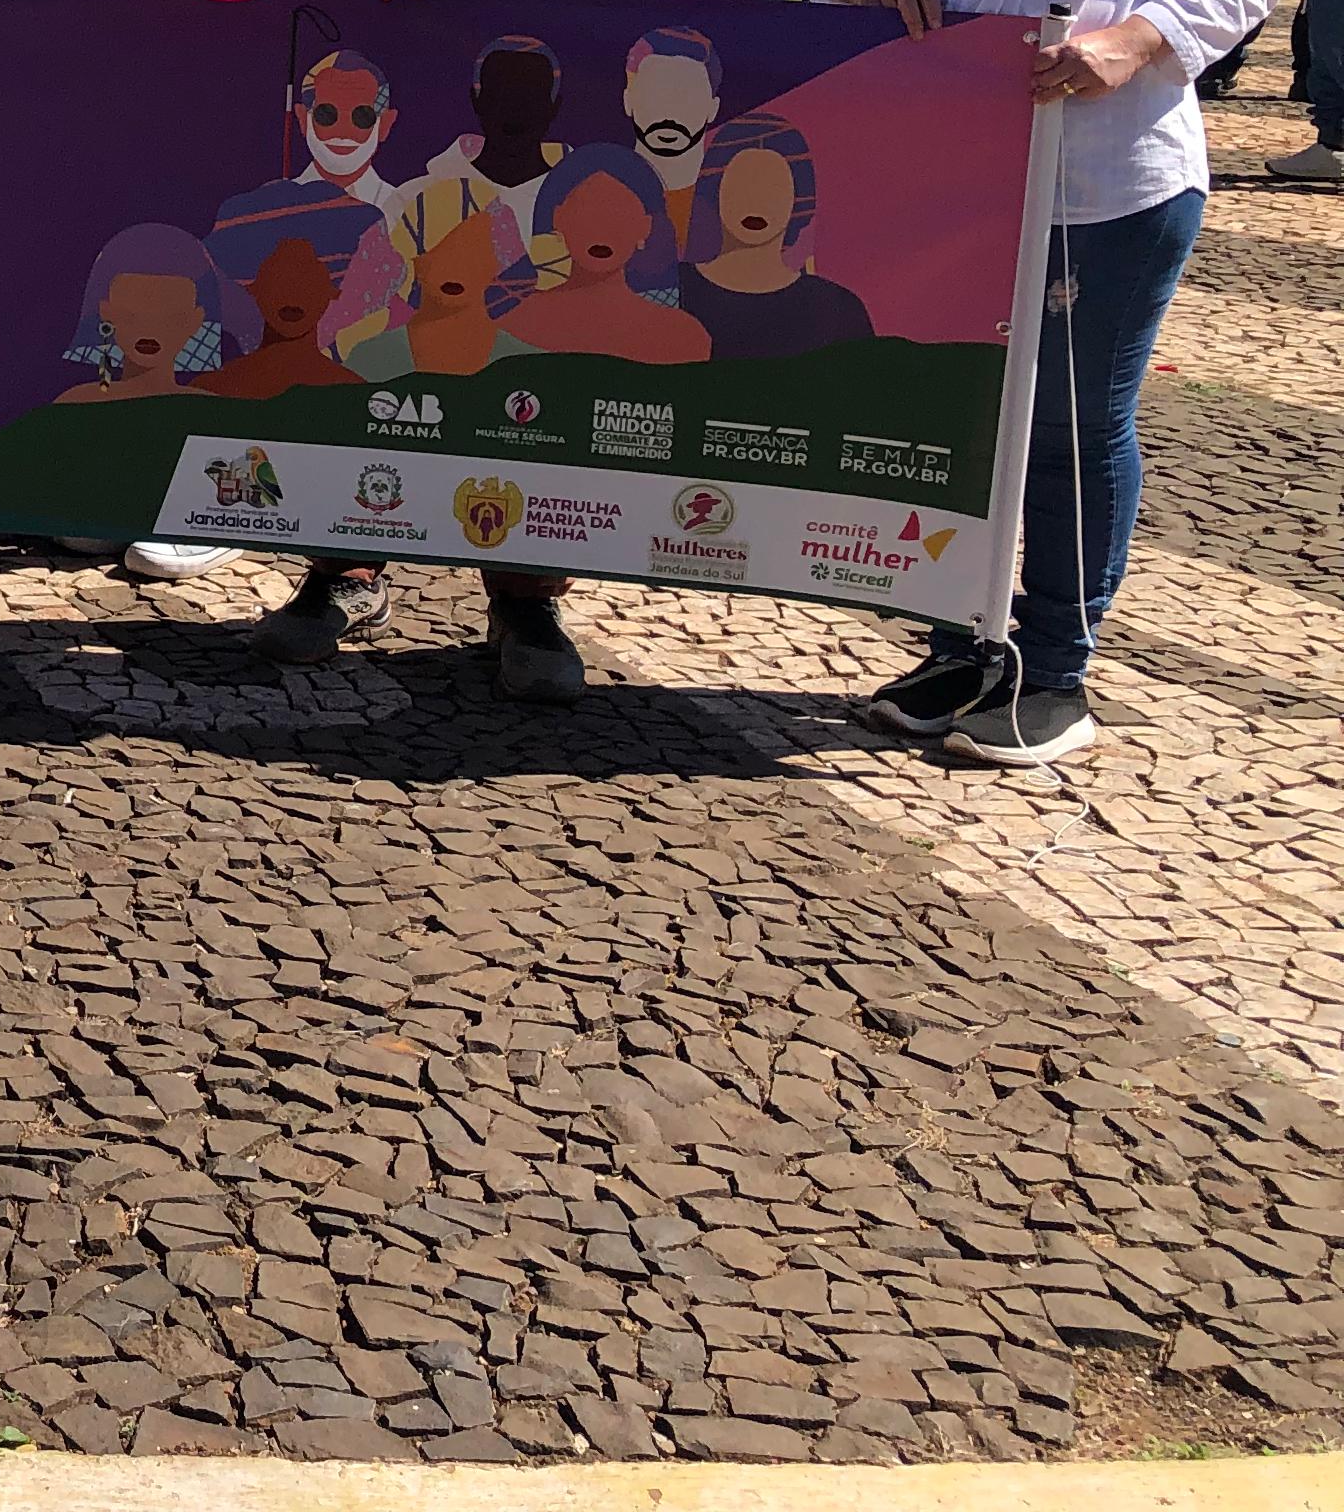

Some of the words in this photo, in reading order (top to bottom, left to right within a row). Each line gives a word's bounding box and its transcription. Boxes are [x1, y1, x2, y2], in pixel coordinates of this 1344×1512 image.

[367, 390, 444, 424] OAB
[594, 399, 674, 421] PARANÁ
[367, 422, 442, 440] PARANÁ
[475, 428, 519, 439] MULHER
[522, 432, 566, 444] SEGURA
[593, 415, 655, 435] UNIDO
[704, 429, 809, 453] SEGURANÇA
[702, 444, 808, 467] PR.GOV.BR
[840, 458, 950, 486] PR.GOV.BR
[527, 496, 623, 517] PATRULHA
[184, 510, 251, 528] Jandaia
[253, 516, 274, 530] do
[276, 517, 300, 533] Sul
[327, 522, 385, 537] Jandaia
[386, 525, 405, 539] do
[406, 528, 428, 541] Sul
[526, 511, 586, 527] MARIA
[590, 516, 617, 530] DA
[806, 521, 879, 540] comitê
[525, 524, 588, 542] PENHA
[651, 536, 748, 561] Mulheres
[800, 538, 919, 572] mulher
[832, 567, 894, 589] Sicredi
